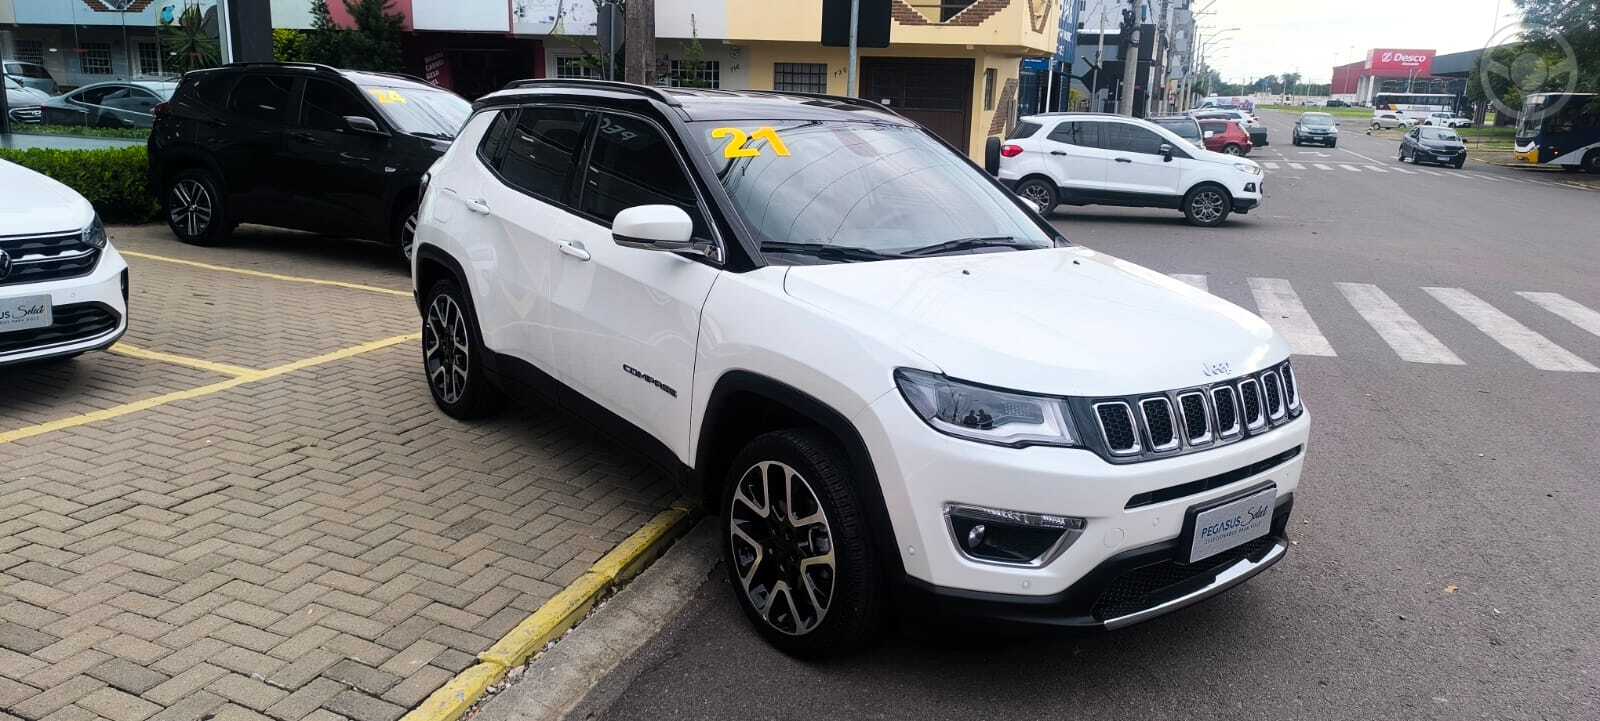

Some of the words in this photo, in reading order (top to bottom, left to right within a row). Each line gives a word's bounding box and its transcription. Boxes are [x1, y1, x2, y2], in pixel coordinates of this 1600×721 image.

[1393, 53, 1426, 62] Desco
[368, 88, 407, 105] 24
[711, 126, 792, 160] 21
[12, 304, 44, 320] Select
[1201, 515, 1241, 538] PEGASUS
[1240, 505, 1269, 526] Select
